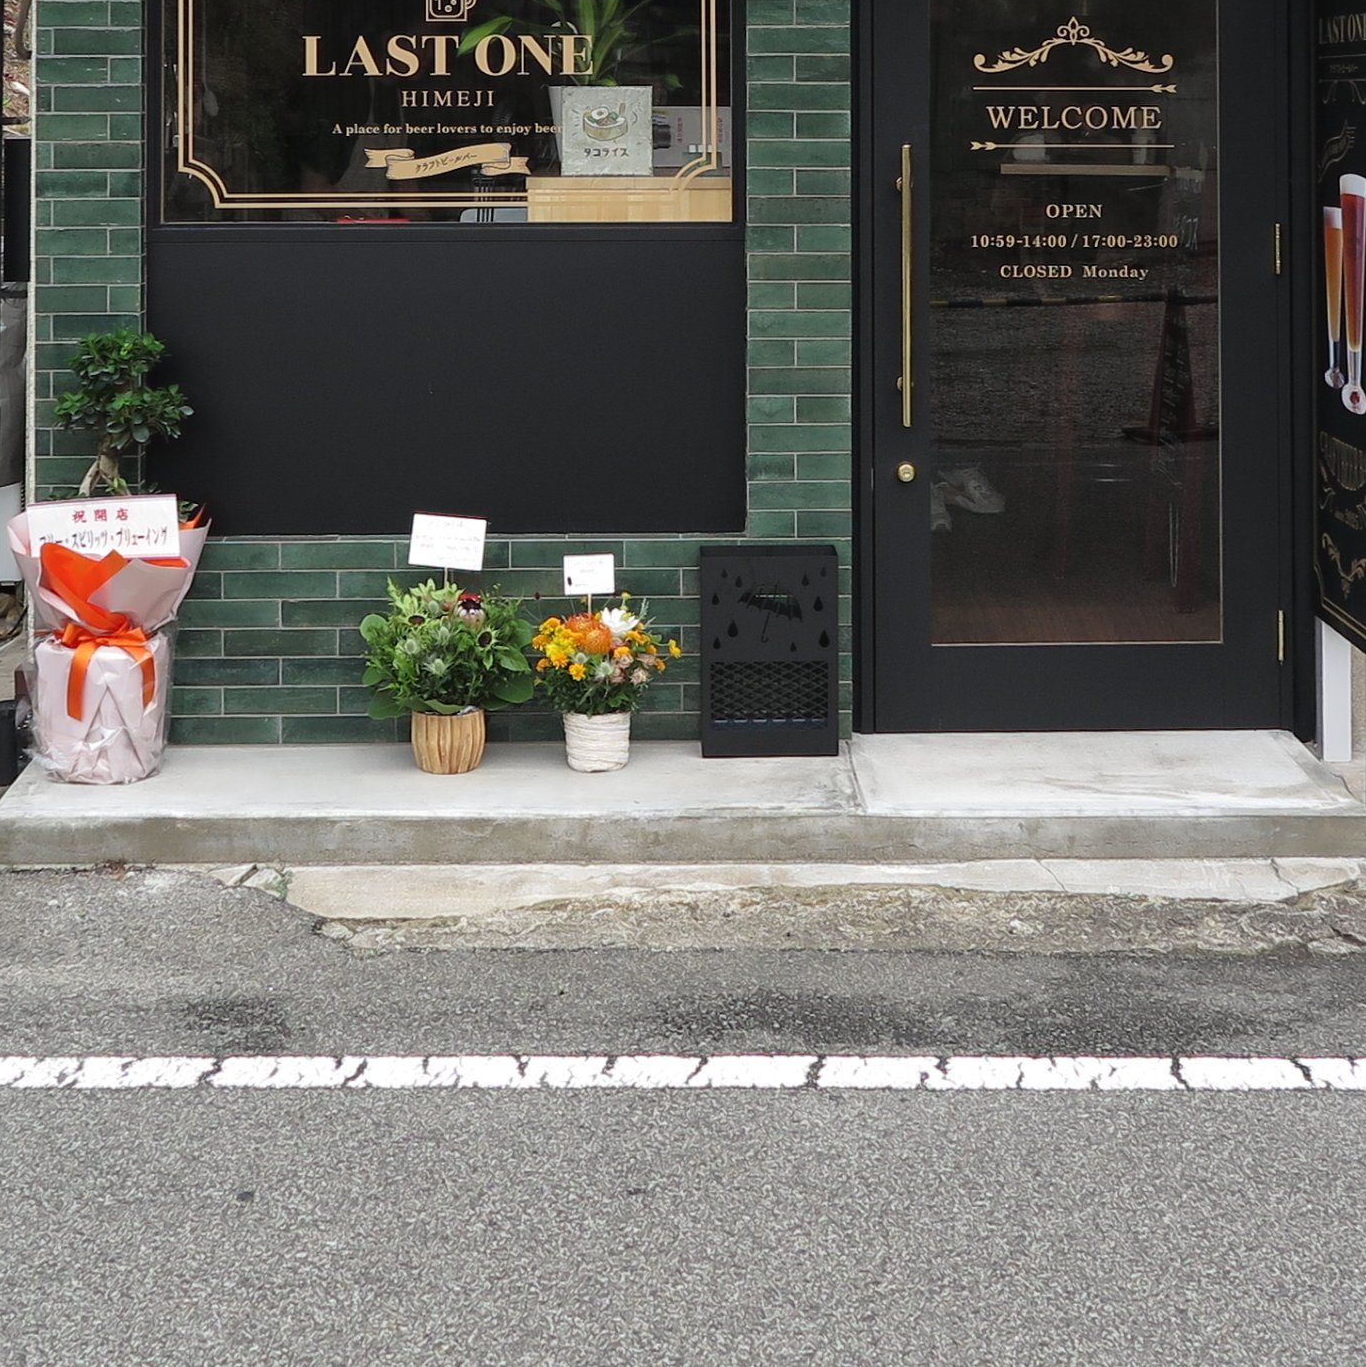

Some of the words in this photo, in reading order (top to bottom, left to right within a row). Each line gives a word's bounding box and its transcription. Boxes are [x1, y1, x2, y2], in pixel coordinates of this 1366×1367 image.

[1319, 14, 1346, 45] LAST
[301, 34, 460, 78] LAST
[473, 33, 594, 78] ONE
[401, 89, 496, 109] HIMEJI
[986, 104, 1163, 131] WELCOME
[331, 123, 343, 135] A
[345, 123, 381, 137] place
[383, 122, 403, 135] for
[405, 123, 434, 135] beer
[437, 123, 478, 135] lovers
[480, 124, 492, 135] to
[495, 123, 532, 137] enjoy
[414, 151, 478, 174] クラフトビールバー
[583, 147, 630, 159] タコライス
[1045, 203, 1103, 219] OPEN
[970, 234, 1068, 249] 10:59-14:00
[1081, 234, 1179, 249] 17:00-23:00
[999, 264, 1073, 280] CLOSED
[1082, 264, 1150, 282] Monday
